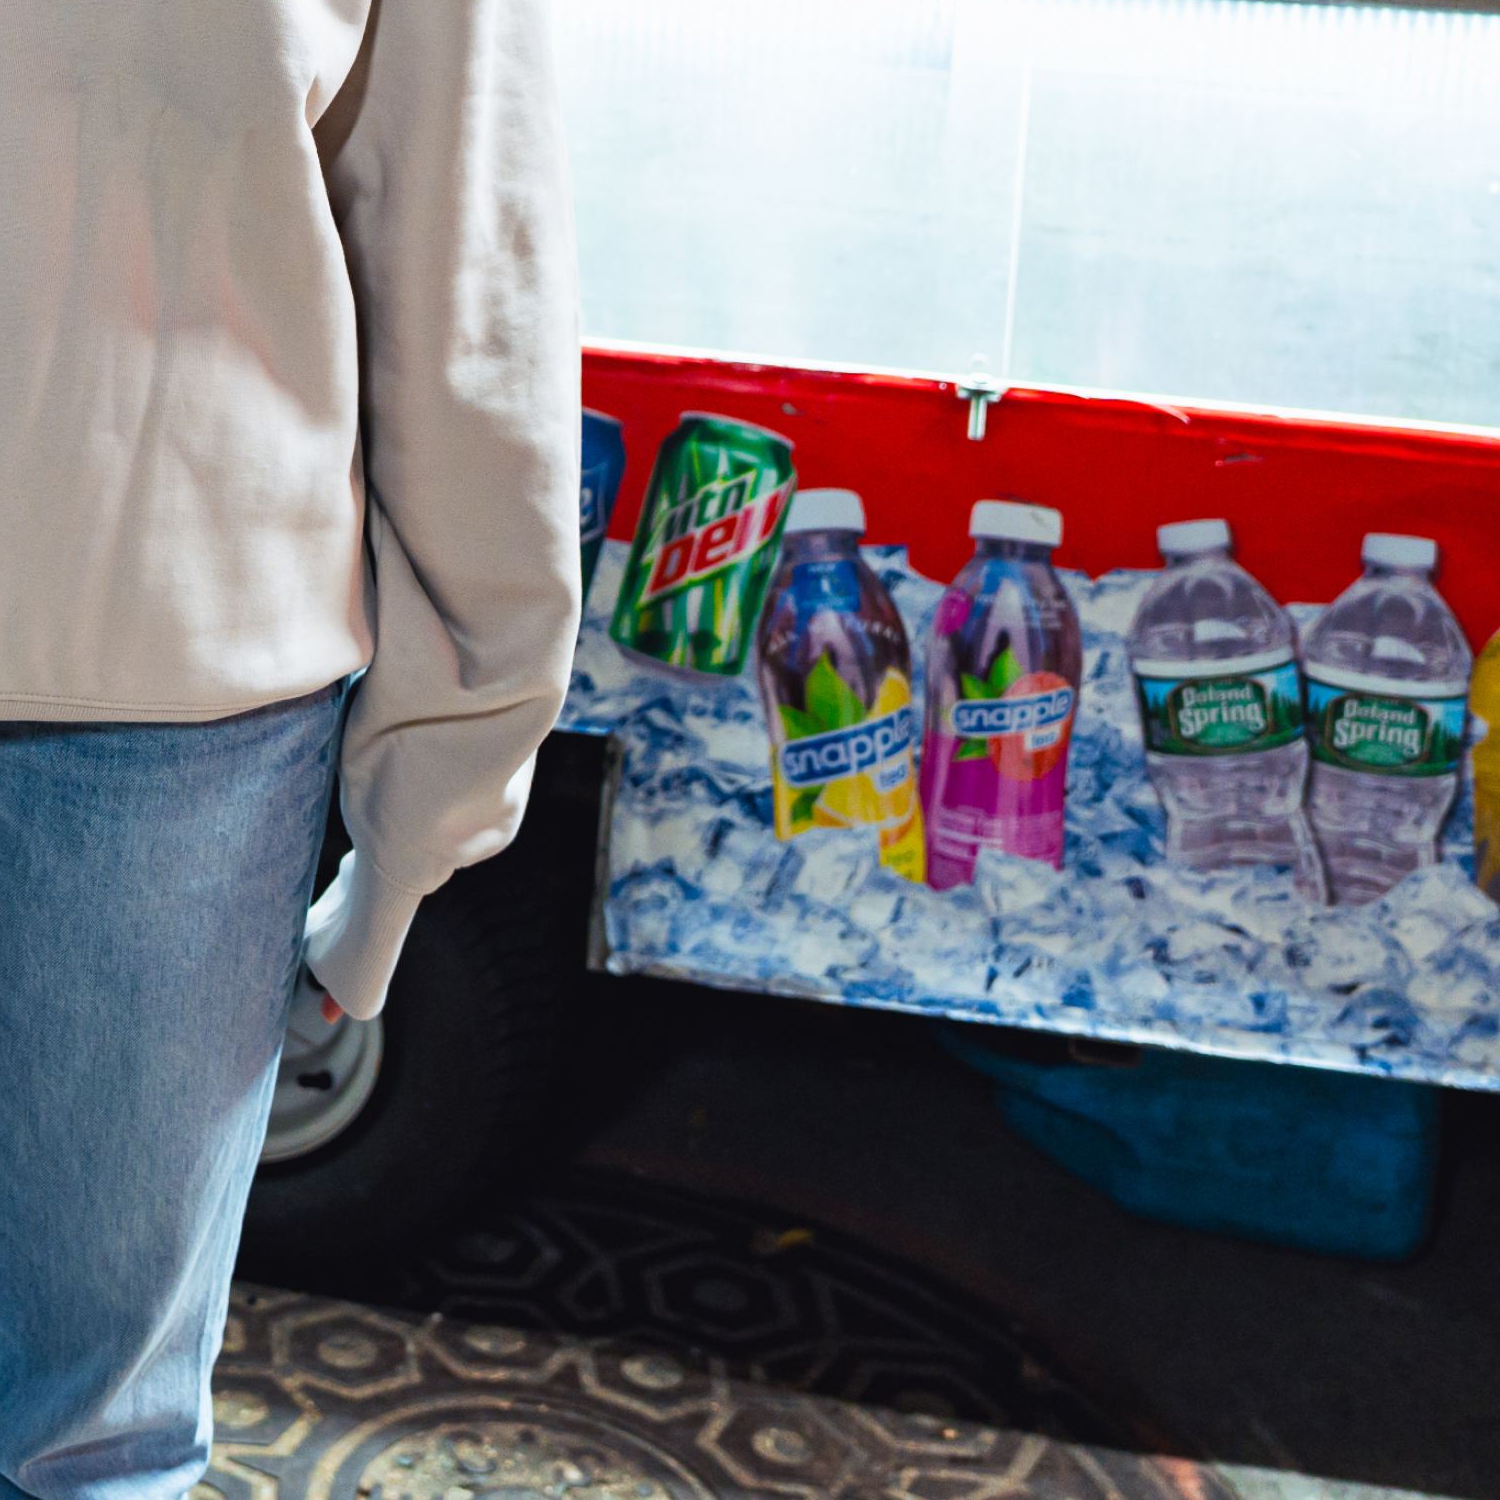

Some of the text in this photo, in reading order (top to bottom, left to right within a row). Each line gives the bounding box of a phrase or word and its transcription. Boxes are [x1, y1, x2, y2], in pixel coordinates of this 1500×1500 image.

[958, 690, 1069, 733] snapple
[1182, 684, 1254, 707] Poland
[1343, 698, 1416, 726] Poland
[1177, 700, 1267, 741] Spring
[1333, 718, 1421, 757] Spring
[784, 709, 910, 777] snapple
